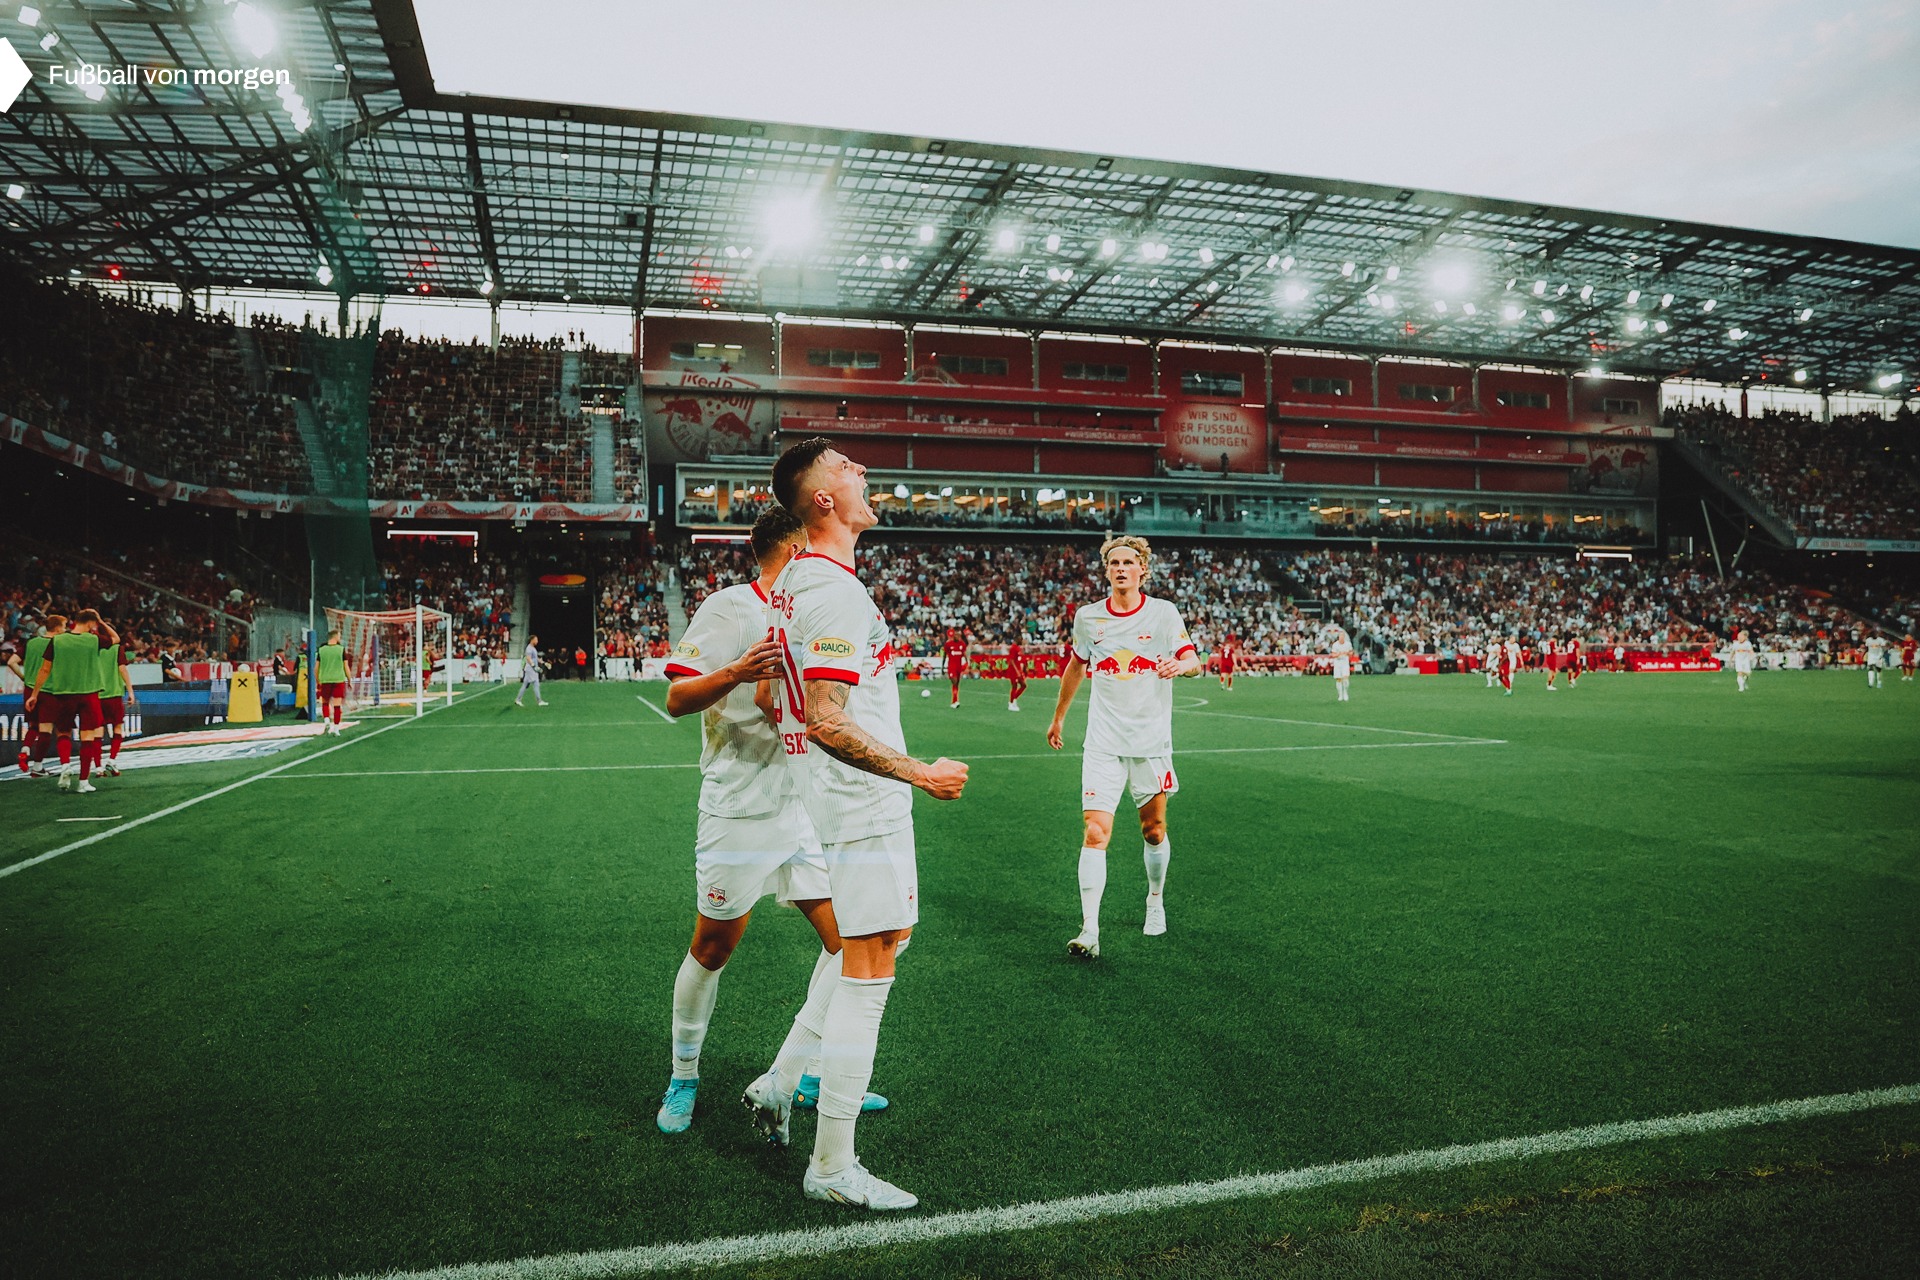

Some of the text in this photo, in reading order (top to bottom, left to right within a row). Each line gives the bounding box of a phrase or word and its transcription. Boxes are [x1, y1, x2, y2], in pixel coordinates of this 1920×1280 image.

[1188, 410, 1237, 422] WIR SIND
[1172, 422, 1252, 435] DER FUSSBALL
[1177, 434, 1248, 447] VON MORGEN
[821, 642, 850, 654] RAUCH
